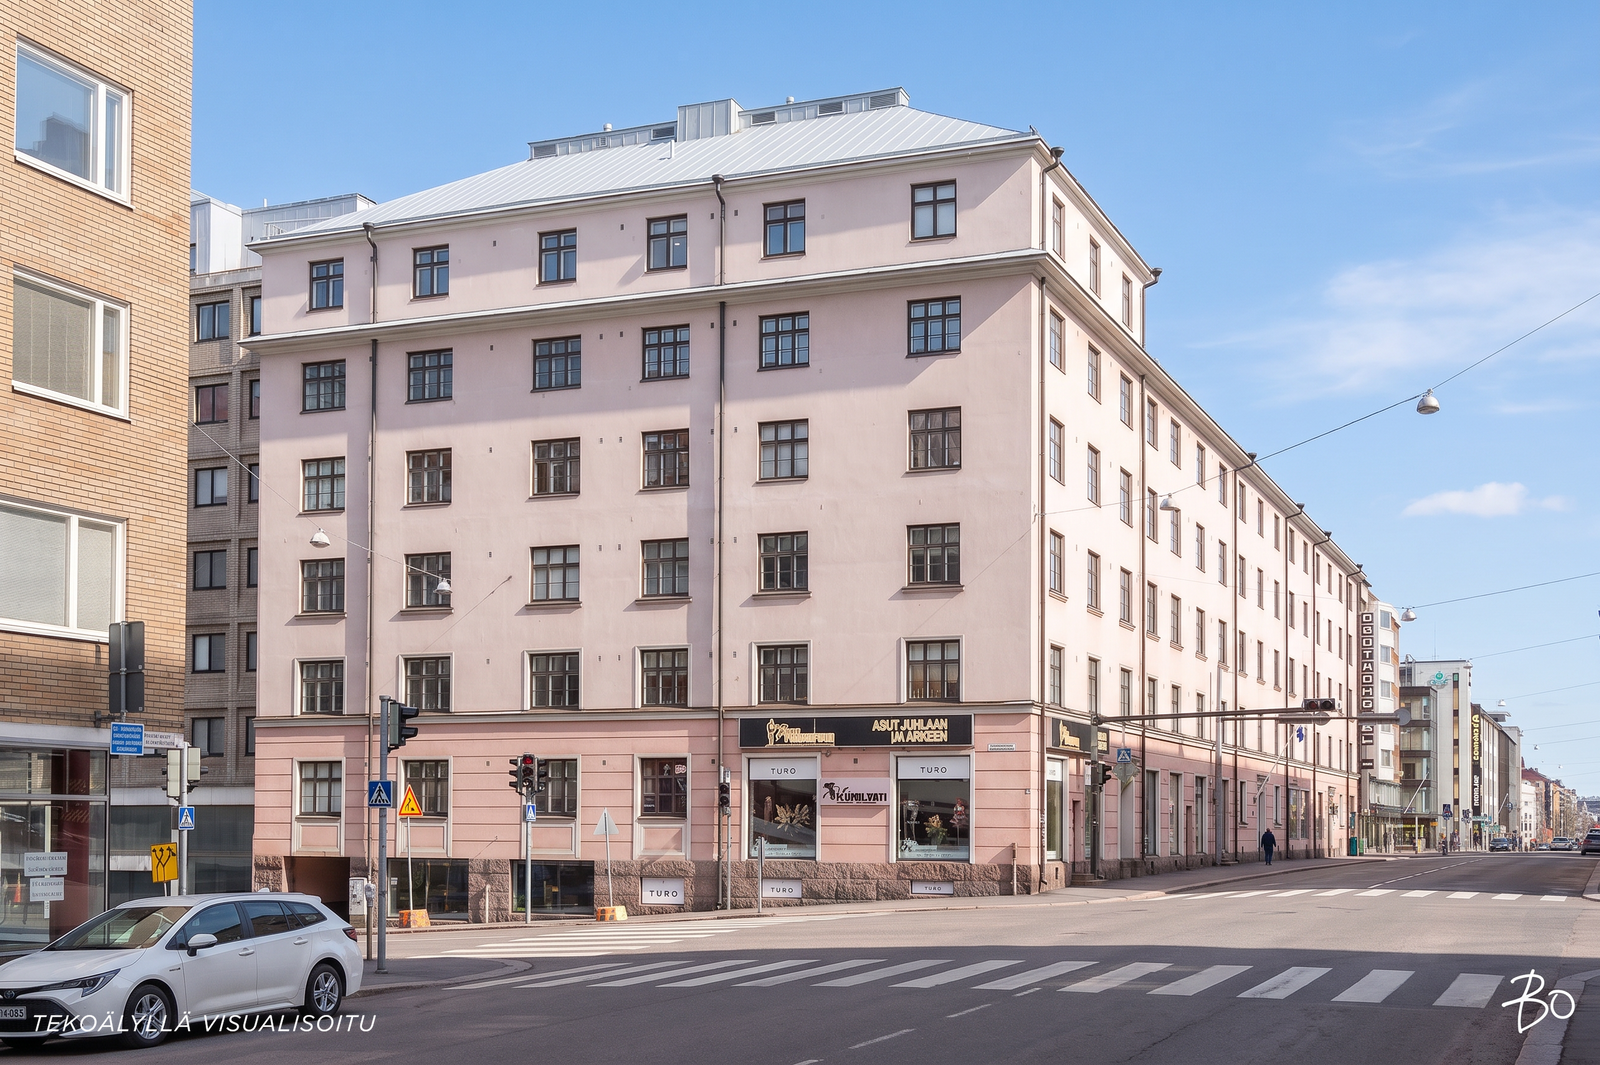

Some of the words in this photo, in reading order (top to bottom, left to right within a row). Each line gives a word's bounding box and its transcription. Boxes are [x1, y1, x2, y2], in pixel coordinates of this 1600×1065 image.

[872, 719, 900, 732] ASUT
[900, 718, 948, 731] JUHLAAN
[906, 730, 948, 743] ARKEEN
[770, 767, 797, 775] TURO
[920, 766, 948, 774] TURO
[649, 890, 678, 898] TURO
